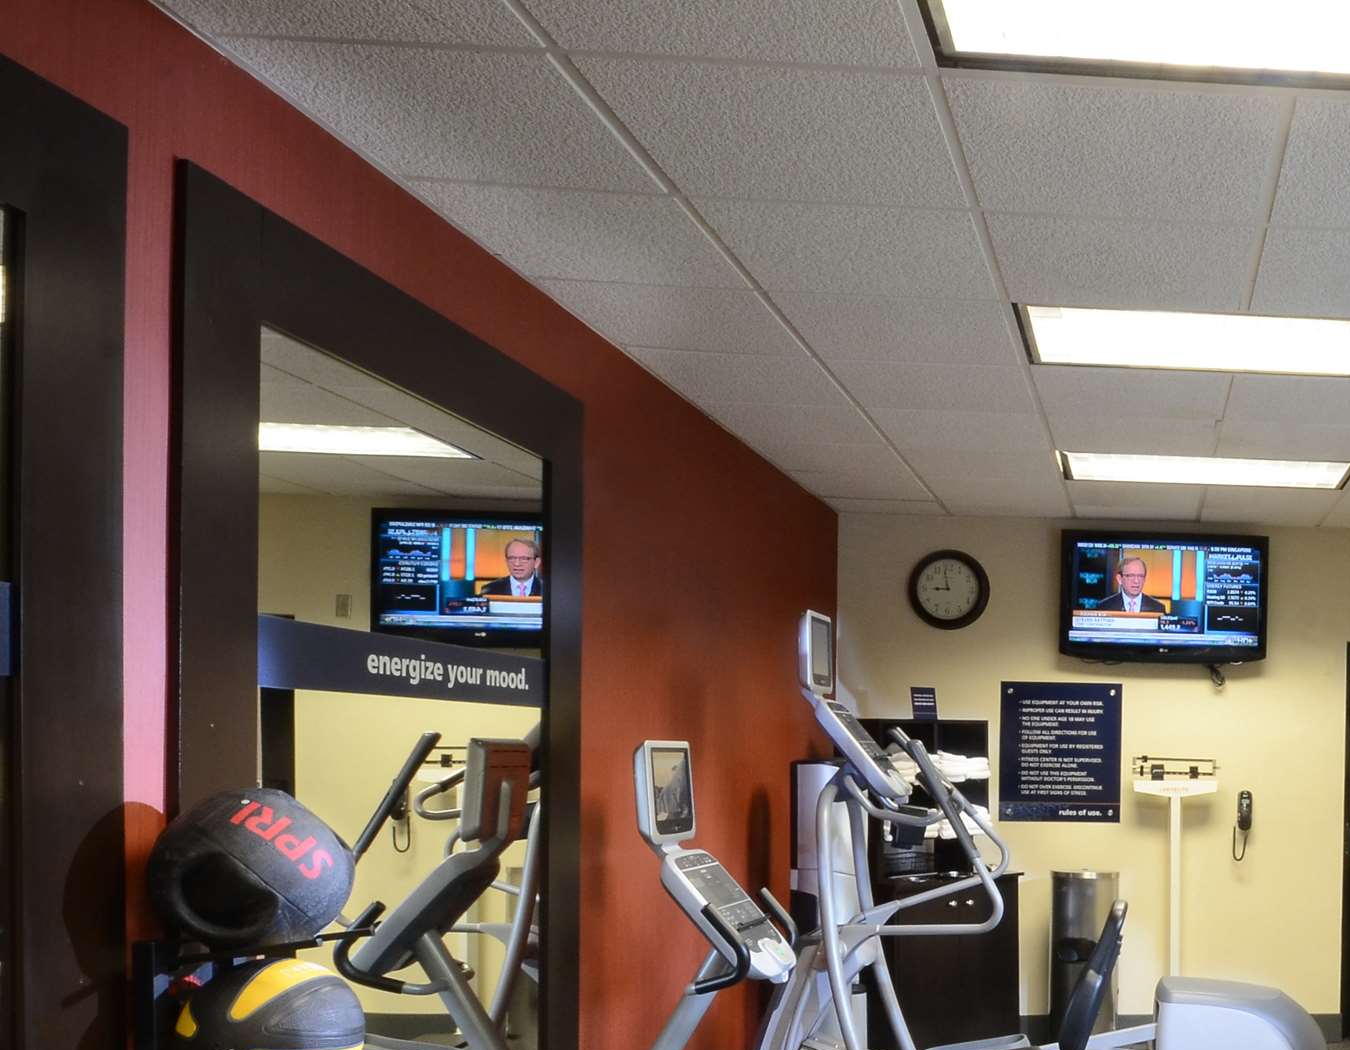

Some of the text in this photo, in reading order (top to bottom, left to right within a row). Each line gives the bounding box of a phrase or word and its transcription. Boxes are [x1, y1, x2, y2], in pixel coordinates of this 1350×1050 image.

[367, 654, 529, 690] energize your mood.
[230, 800, 334, 880] SPRI
